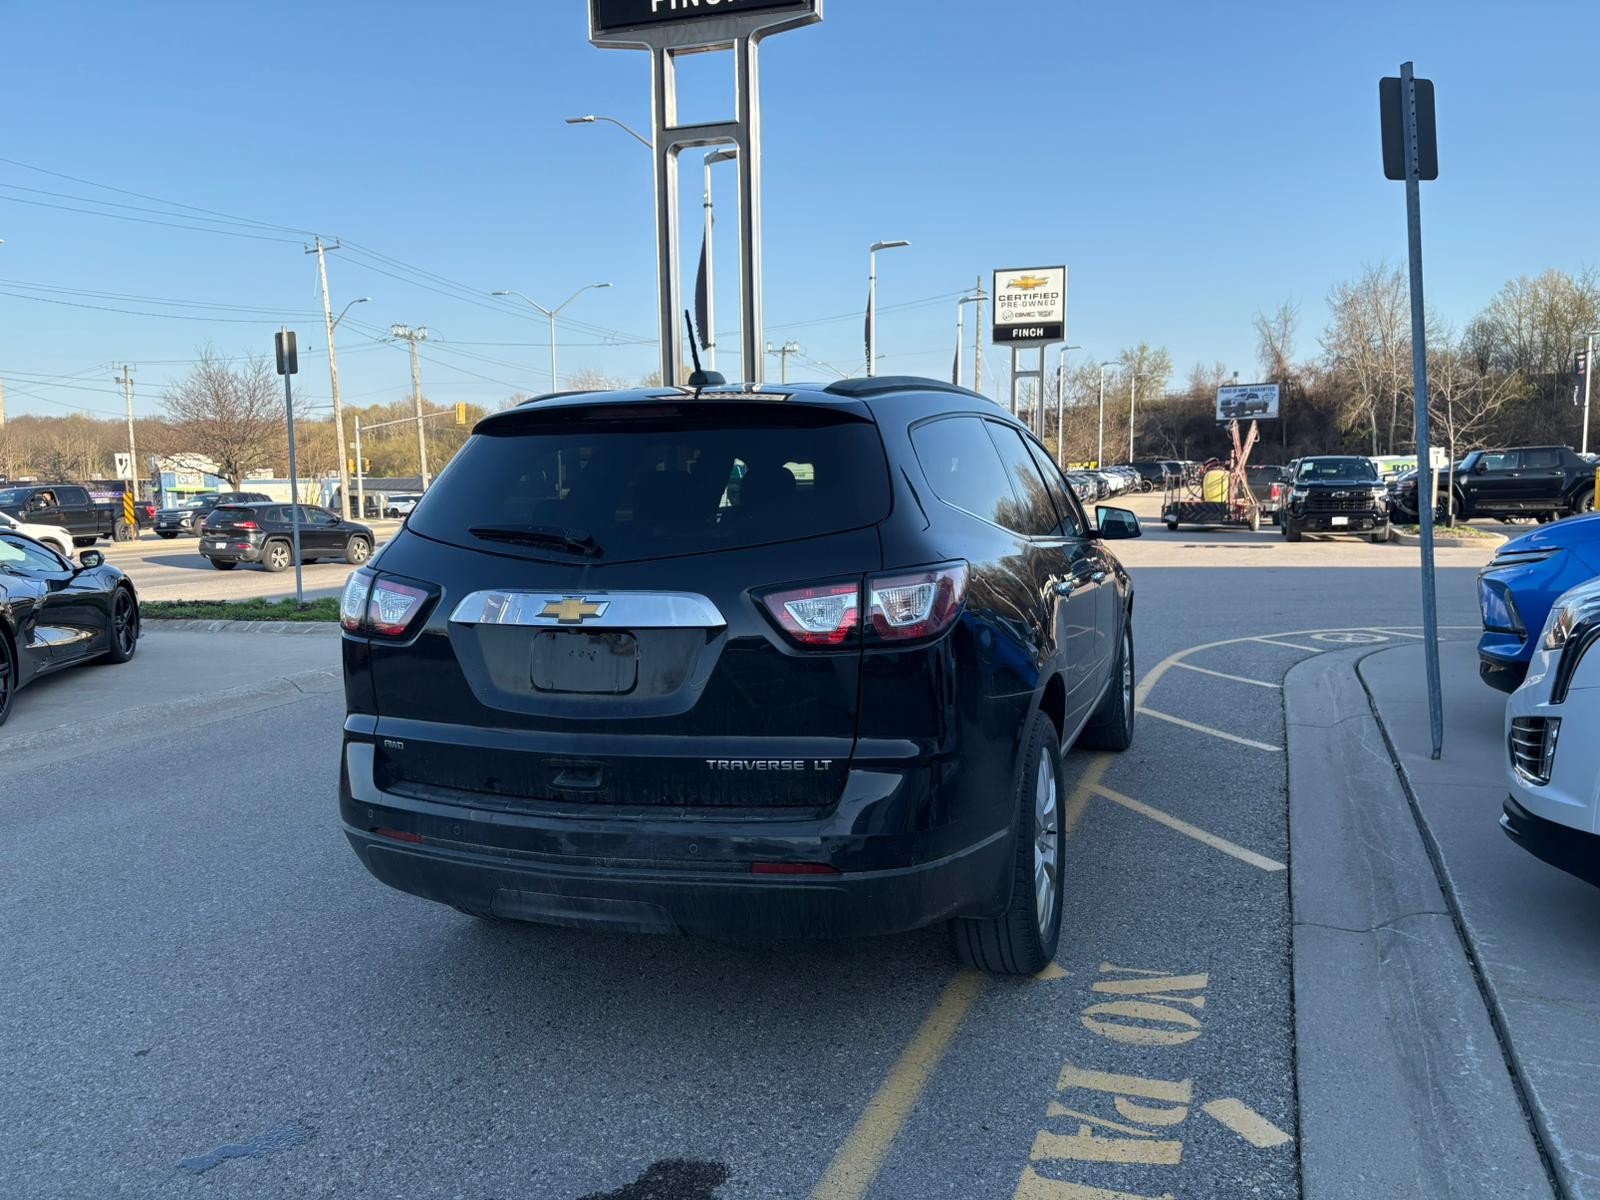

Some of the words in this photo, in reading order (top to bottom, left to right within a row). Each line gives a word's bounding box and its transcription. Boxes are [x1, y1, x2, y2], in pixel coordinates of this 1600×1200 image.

[998, 292, 1059, 301] CERTIFIED
[1000, 299, 1056, 308] PRE-OWNED
[1012, 328, 1044, 338] FINCH
[384, 739, 404, 750] AWD
[705, 759, 805, 771] TRAVERSE
[814, 759, 833, 771] LT
[1080, 961, 1209, 1046] NO
